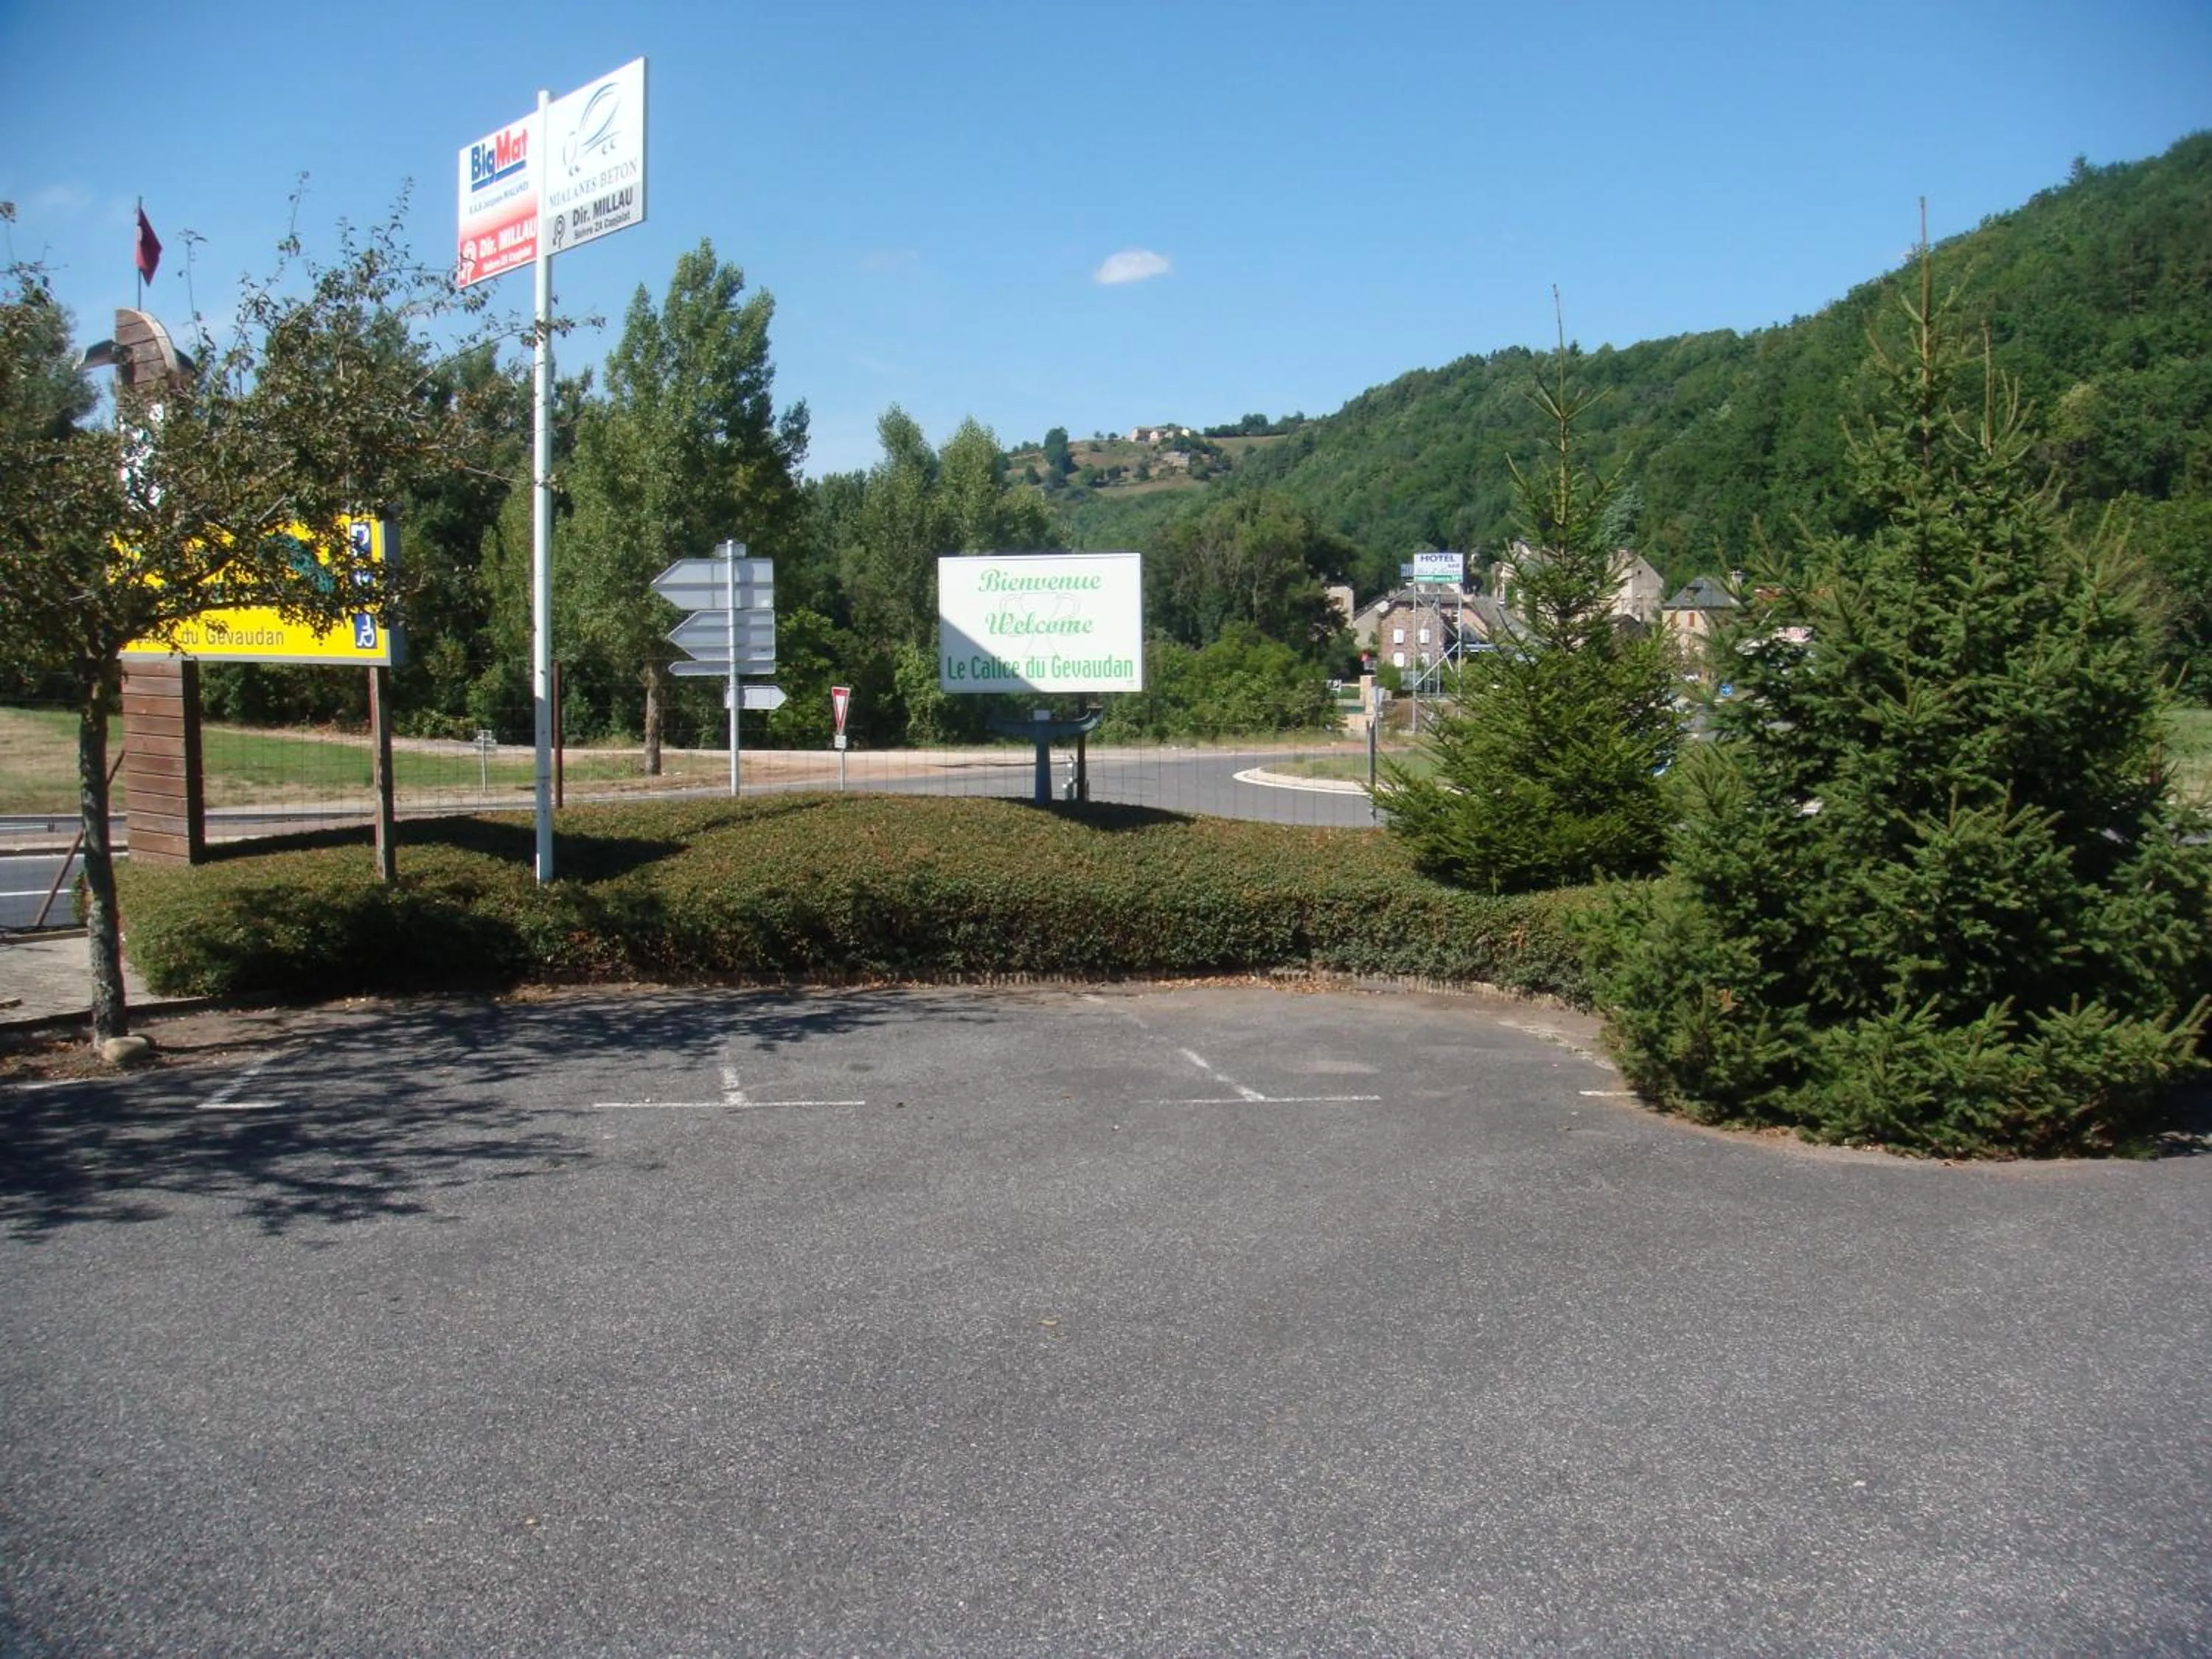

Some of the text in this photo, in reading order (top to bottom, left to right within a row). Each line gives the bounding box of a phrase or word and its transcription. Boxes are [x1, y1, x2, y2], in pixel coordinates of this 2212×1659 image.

[471, 128, 528, 182] BigMat
[600, 157, 638, 188] BETON
[572, 206, 591, 226] Dir.
[592, 187, 633, 220] MILLAU
[498, 218, 537, 251] MILLAU
[1420, 554, 1457, 562] HOTEL
[978, 568, 1103, 593] Bienvenue
[985, 612, 1094, 635] Welcome
[947, 653, 1134, 680] Le Calice du Gevaudan
